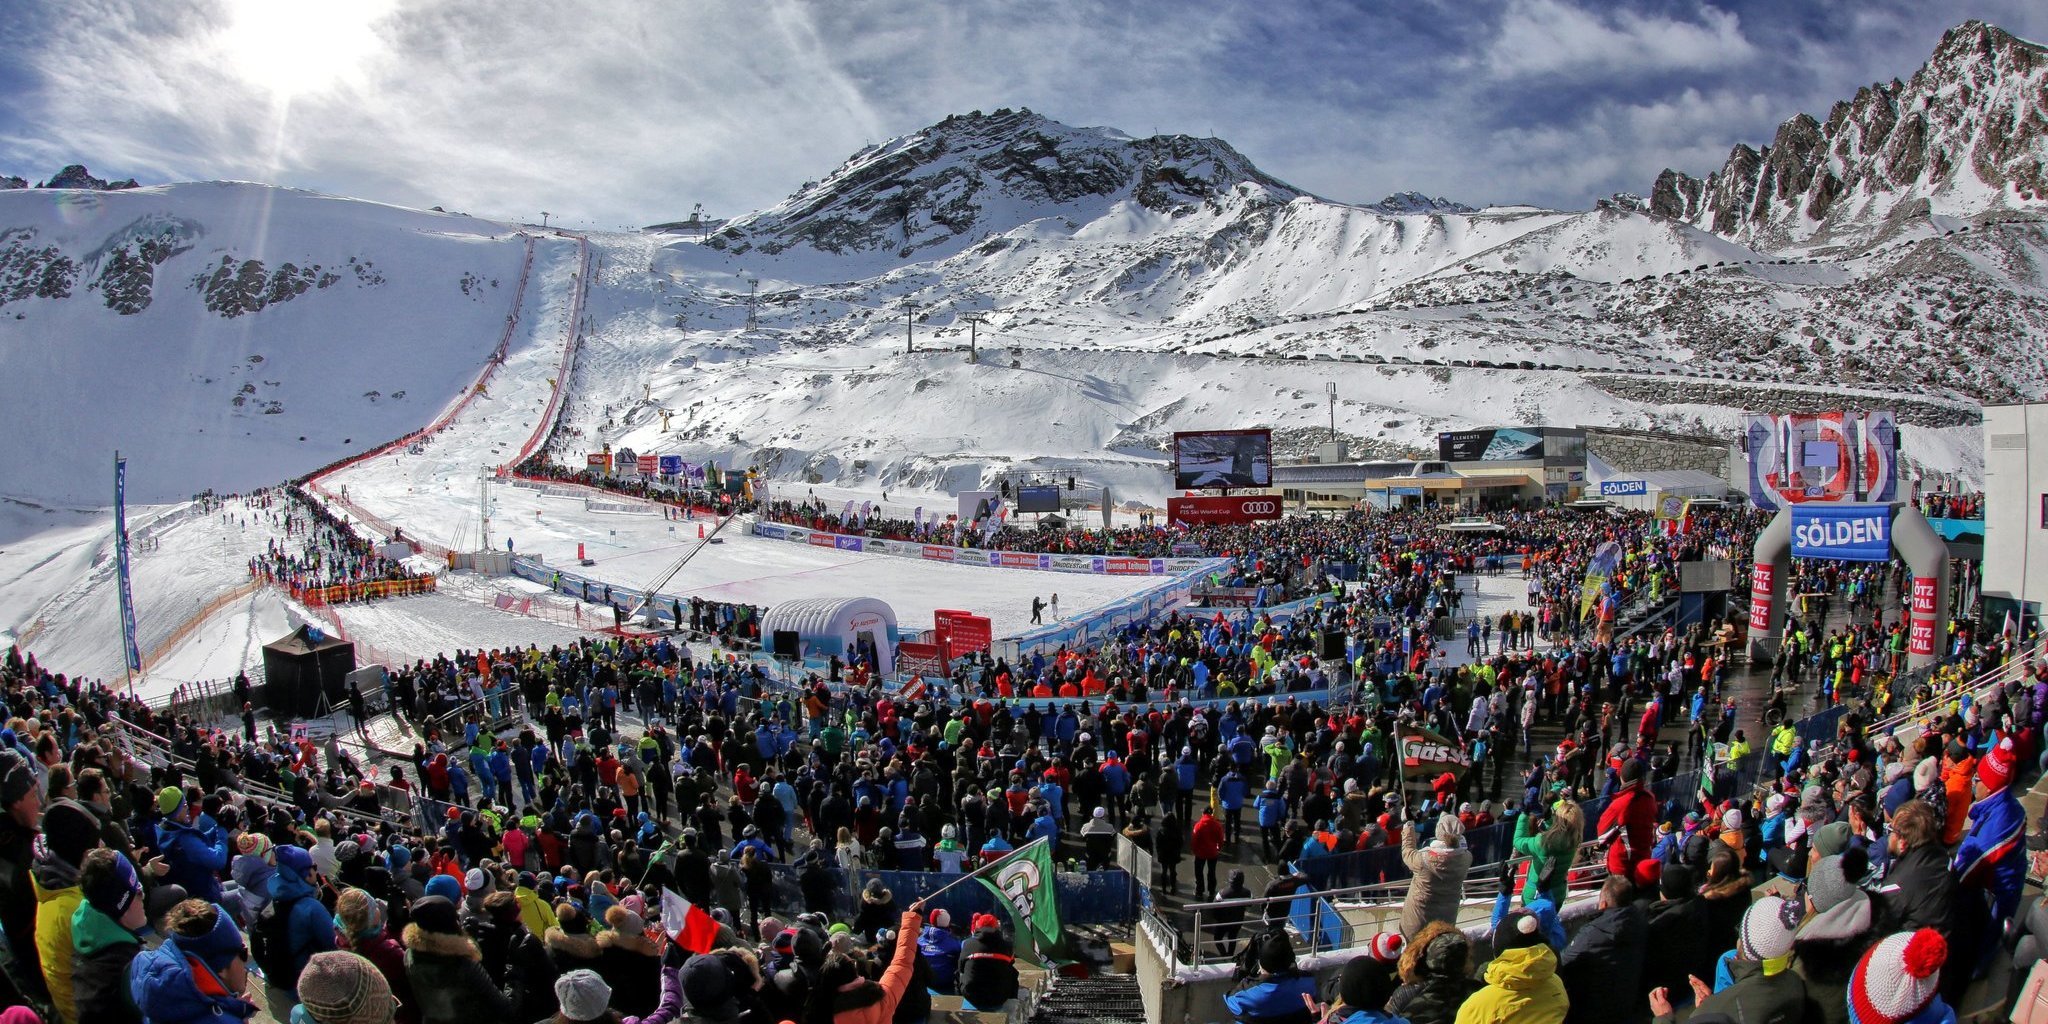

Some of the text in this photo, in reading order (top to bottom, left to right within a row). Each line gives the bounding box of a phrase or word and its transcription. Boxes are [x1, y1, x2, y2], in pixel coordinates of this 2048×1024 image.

[1603, 481, 1643, 495] SÖLDEN
[1795, 516, 1883, 548] SÖLDEN
[1053, 560, 1090, 569] BRIDGESTONE
[1106, 561, 1148, 571] Kronen Zeitung
[1753, 566, 1771, 581] ÖTZ
[1753, 581, 1770, 592] TAL
[1914, 580, 1934, 597] ÖTZ
[1751, 601, 1768, 616] ÖTZ
[1914, 597, 1933, 609] TAL
[1750, 615, 1766, 626] TAL
[1912, 622, 1932, 638] ÖTZ
[1911, 638, 1930, 651] TAL
